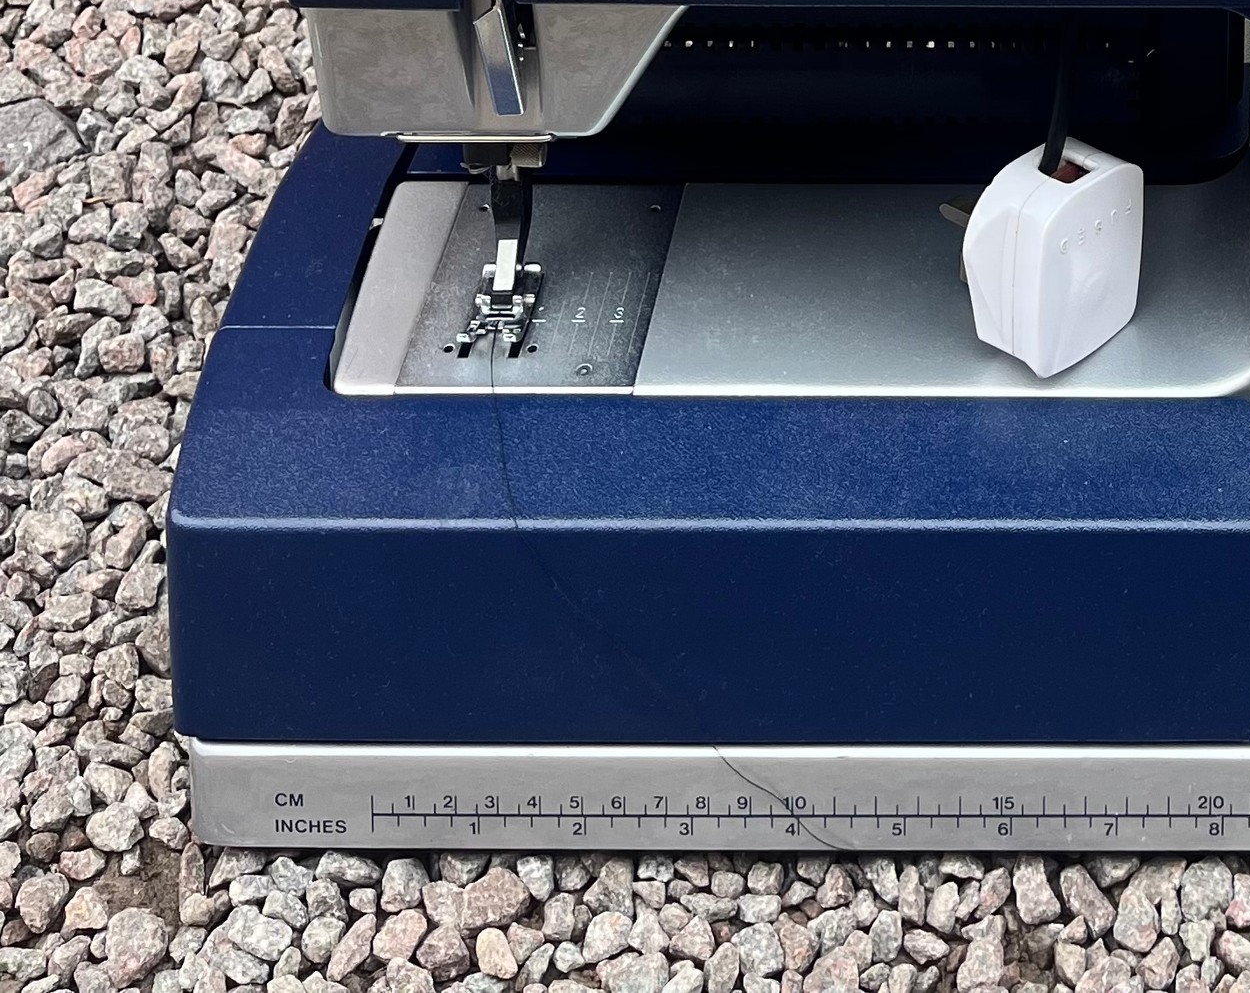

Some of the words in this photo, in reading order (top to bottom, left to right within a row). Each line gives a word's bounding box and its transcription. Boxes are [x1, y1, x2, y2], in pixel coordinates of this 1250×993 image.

[575, 307, 586, 319] 2
[275, 793, 303, 806] CM
[442, 796, 455, 809] 2
[484, 796, 496, 809] 3
[526, 796, 539, 809] 4
[569, 796, 581, 809] 5
[611, 796, 623, 809] 6
[653, 796, 664, 809] 7
[695, 796, 707, 809] 8
[737, 796, 749, 809] 9
[276, 820, 346, 833] INCHES
[469, 822, 478, 835] 1
[572, 822, 584, 835] 2
[679, 822, 691, 835] 3
[784, 822, 797, 835] 4
[891, 822, 903, 837] 5
[997, 822, 1009, 837] 6
[1103, 822, 1114, 837] 7
[1208, 822, 1220, 837] 8
